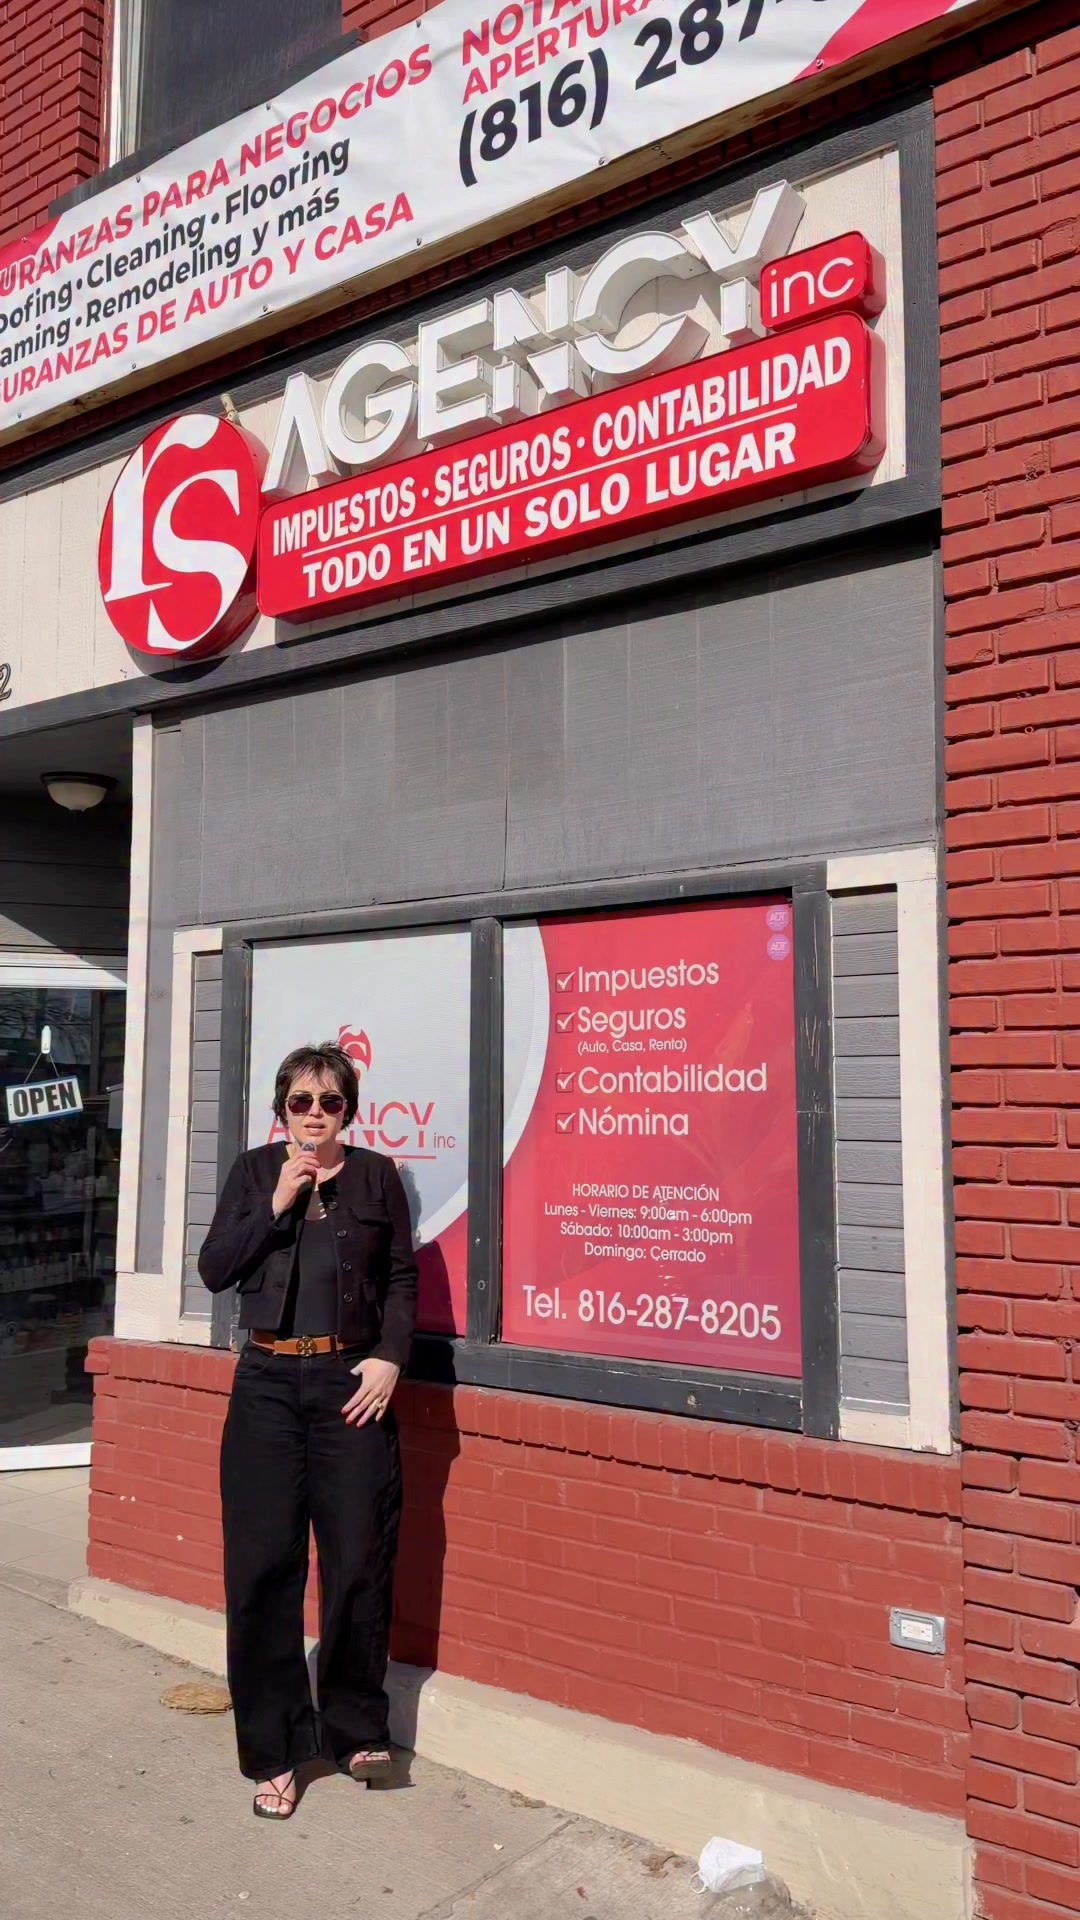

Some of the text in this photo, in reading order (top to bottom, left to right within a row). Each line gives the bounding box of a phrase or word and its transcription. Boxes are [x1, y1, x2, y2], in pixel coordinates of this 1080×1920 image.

[462, 0, 654, 105] APERTUR
[458, 0, 827, 187] (816) 287
[142, 158, 230, 227] PARA
[239, 44, 433, 176] NEGOCIOS
[87, 214, 206, 288] Cleaning
[225, 138, 350, 224] Flooring
[86, 234, 241, 328] Remodeling
[251, 221, 269, 256] y
[278, 186, 340, 237] más
[137, 298, 176, 344] DE
[184, 257, 273, 322] AUTO
[283, 238, 305, 275] Y
[314, 192, 414, 261] CASA
[770, 257, 855, 318] inc
[261, 179, 790, 492] AGENCY
[272, 335, 851, 557] IMPUESTOS SEGUROS CONTABILIDAD
[302, 422, 797, 599] TODO EN UN SOLO LUGAR
[578, 959, 720, 996] Impuestos
[577, 1006, 687, 1038] Seguros
[577, 1038, 687, 1056] (Auto, Casa, Renta)
[12, 1082, 77, 1118] OPEN
[578, 1062, 767, 1094] Contabilidad
[267, 1101, 456, 1149] ANCY inc
[578, 1105, 689, 1136] Nómina
[544, 1202, 579, 1216] Lunes
[588, 1204, 637, 1219] Viernes:
[640, 1206, 689, 1221] 9:00am
[700, 1208, 752, 1226] 6:00pm
[572, 1183, 720, 1201] HORARIO DE ATENCIÓN
[560, 1221, 613, 1237] Sábado:
[618, 1224, 671, 1240] 10:00am
[682, 1228, 733, 1246] 3:00pm
[584, 1242, 706, 1262] Domingo: Cerrado
[522, 1284, 781, 1340] Tel. 816-287-8205
